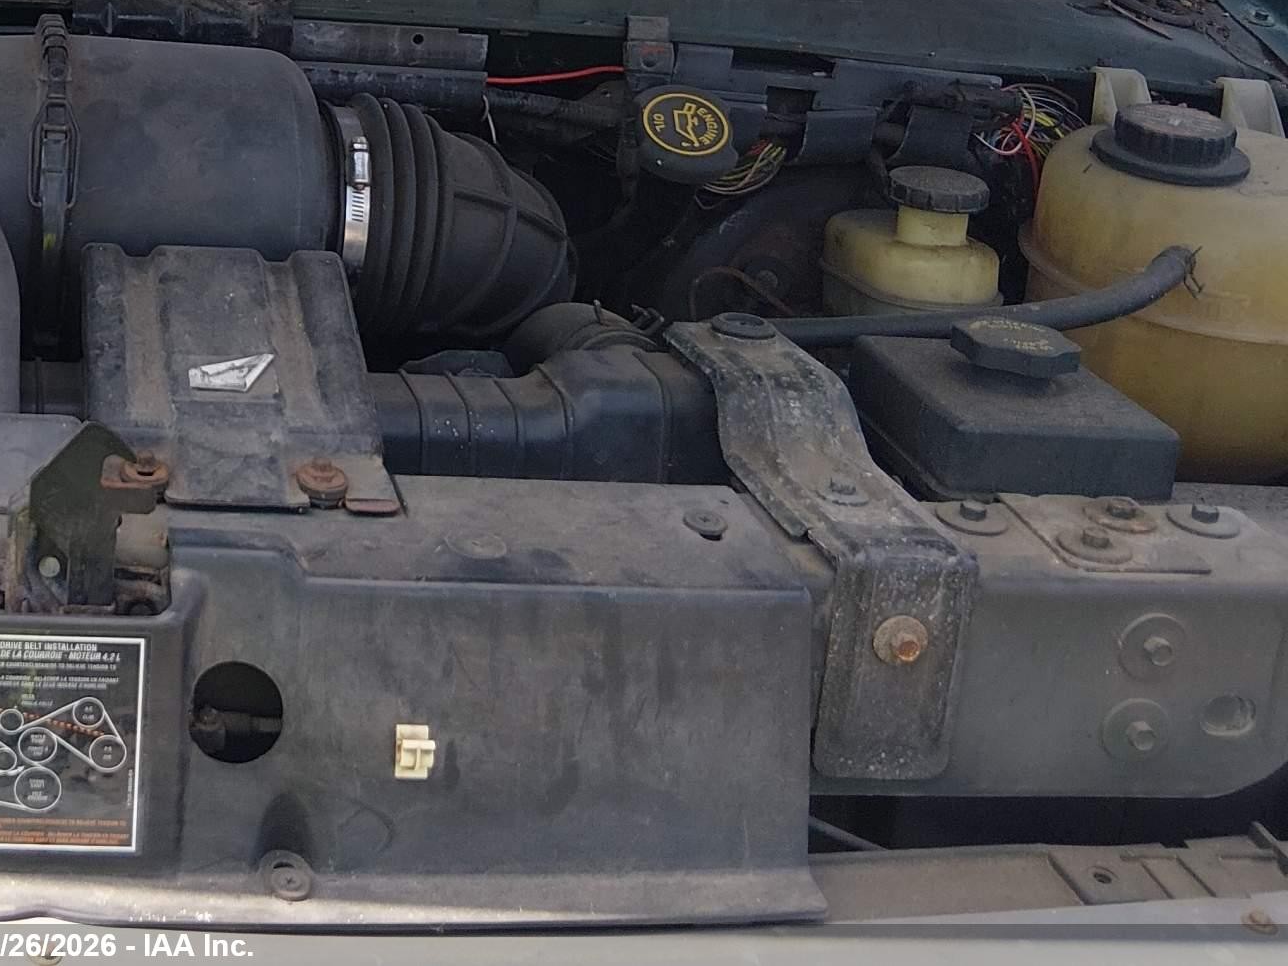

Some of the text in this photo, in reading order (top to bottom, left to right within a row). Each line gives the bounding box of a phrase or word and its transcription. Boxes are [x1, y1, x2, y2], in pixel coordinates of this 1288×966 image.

[652, 112, 667, 133] OIL
[697, 107, 718, 145] ENGINE
[0, 642, 23, 651] DRIVE
[25, 642, 42, 651] BELT
[44, 642, 97, 652] INSTALLATION
[0, 649, 11, 658] DE
[12, 649, 22, 658] LA
[69, 651, 101, 661] MOTEUR
